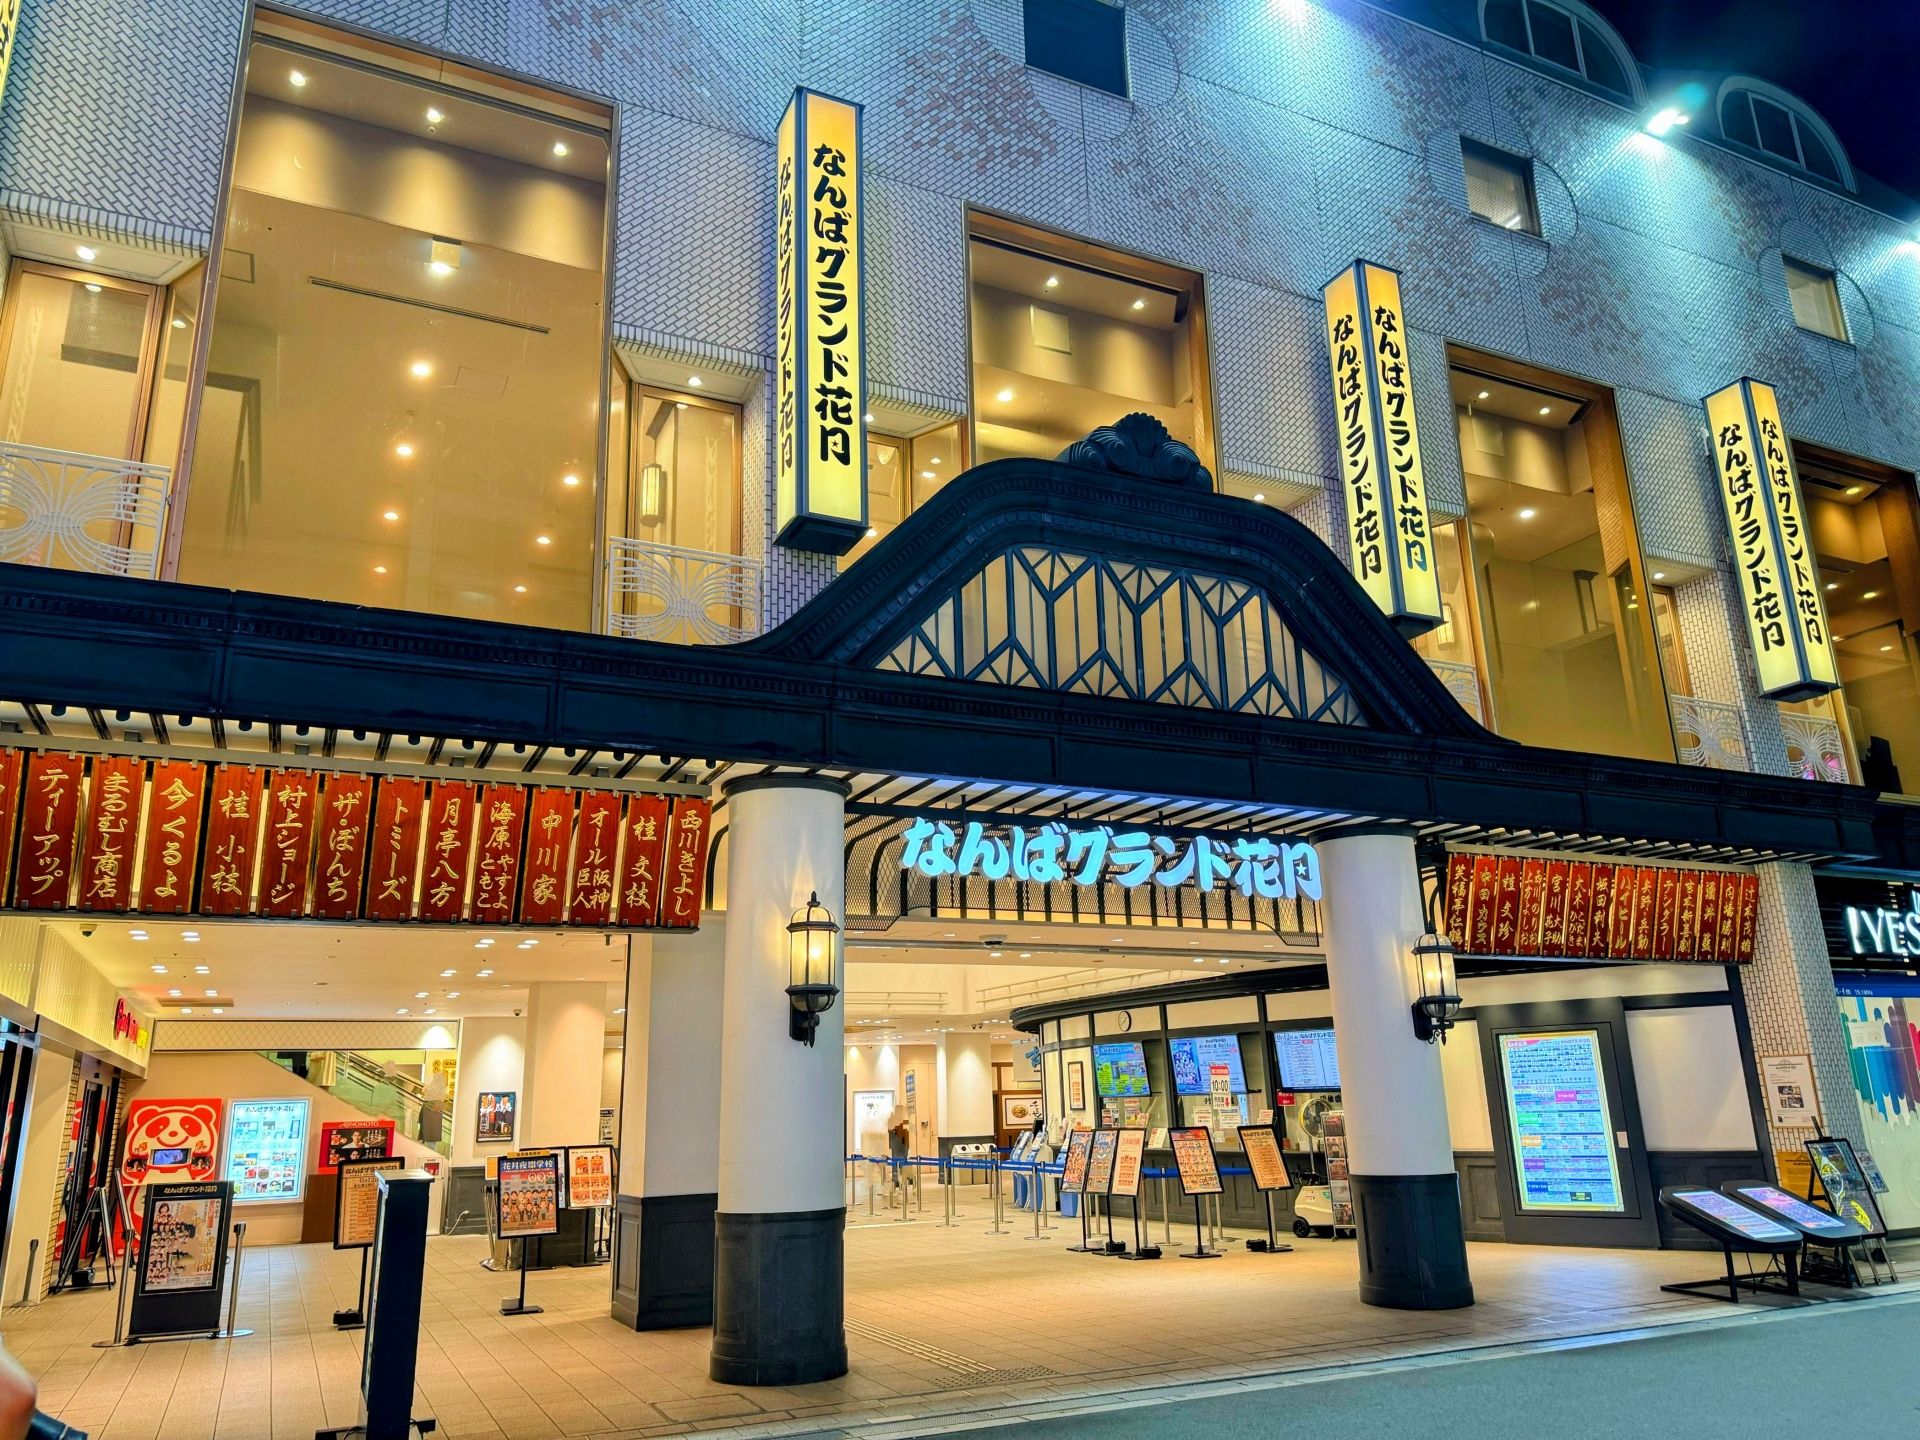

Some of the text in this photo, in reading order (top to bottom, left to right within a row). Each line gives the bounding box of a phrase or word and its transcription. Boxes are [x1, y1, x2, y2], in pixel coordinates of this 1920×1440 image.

[779, 156, 794, 477] なんばグランド花月
[813, 142, 853, 467] なんばグランド花月
[1333, 314, 1383, 581] なんばグランド花月
[1375, 304, 1428, 572] なんばグランド花月
[1719, 423, 1786, 652] なんばグランド花月
[1761, 417, 1823, 645] なんばグランド花月
[31, 768, 69, 895] ティーアップ
[86, 771, 130, 898] まるむし商店
[154, 778, 195, 897] 今くるよ
[210, 789, 250, 896] 桂小枝
[271, 785, 307, 904] 村上ショージ
[327, 791, 363, 902] ザ・ぼんち
[378, 799, 408, 899] トミーズ
[430, 798, 461, 907] 月亭八方
[532, 809, 562, 905] 中川家
[625, 816, 657, 910] 桂文枝
[672, 810, 704, 916] 西川きよし
[903, 817, 1321, 900] なんばグランド花月
[1449, 864, 1468, 945] 笑福亭仁鶴
[1475, 866, 1492, 945] 中田カウス
[1615, 875, 1632, 949] ハイヒール
[1660, 879, 1674, 951] テンダラー
[1678, 879, 1696, 954] 吉本新喜劇
[1212, 1080, 1229, 1092] 10:00
